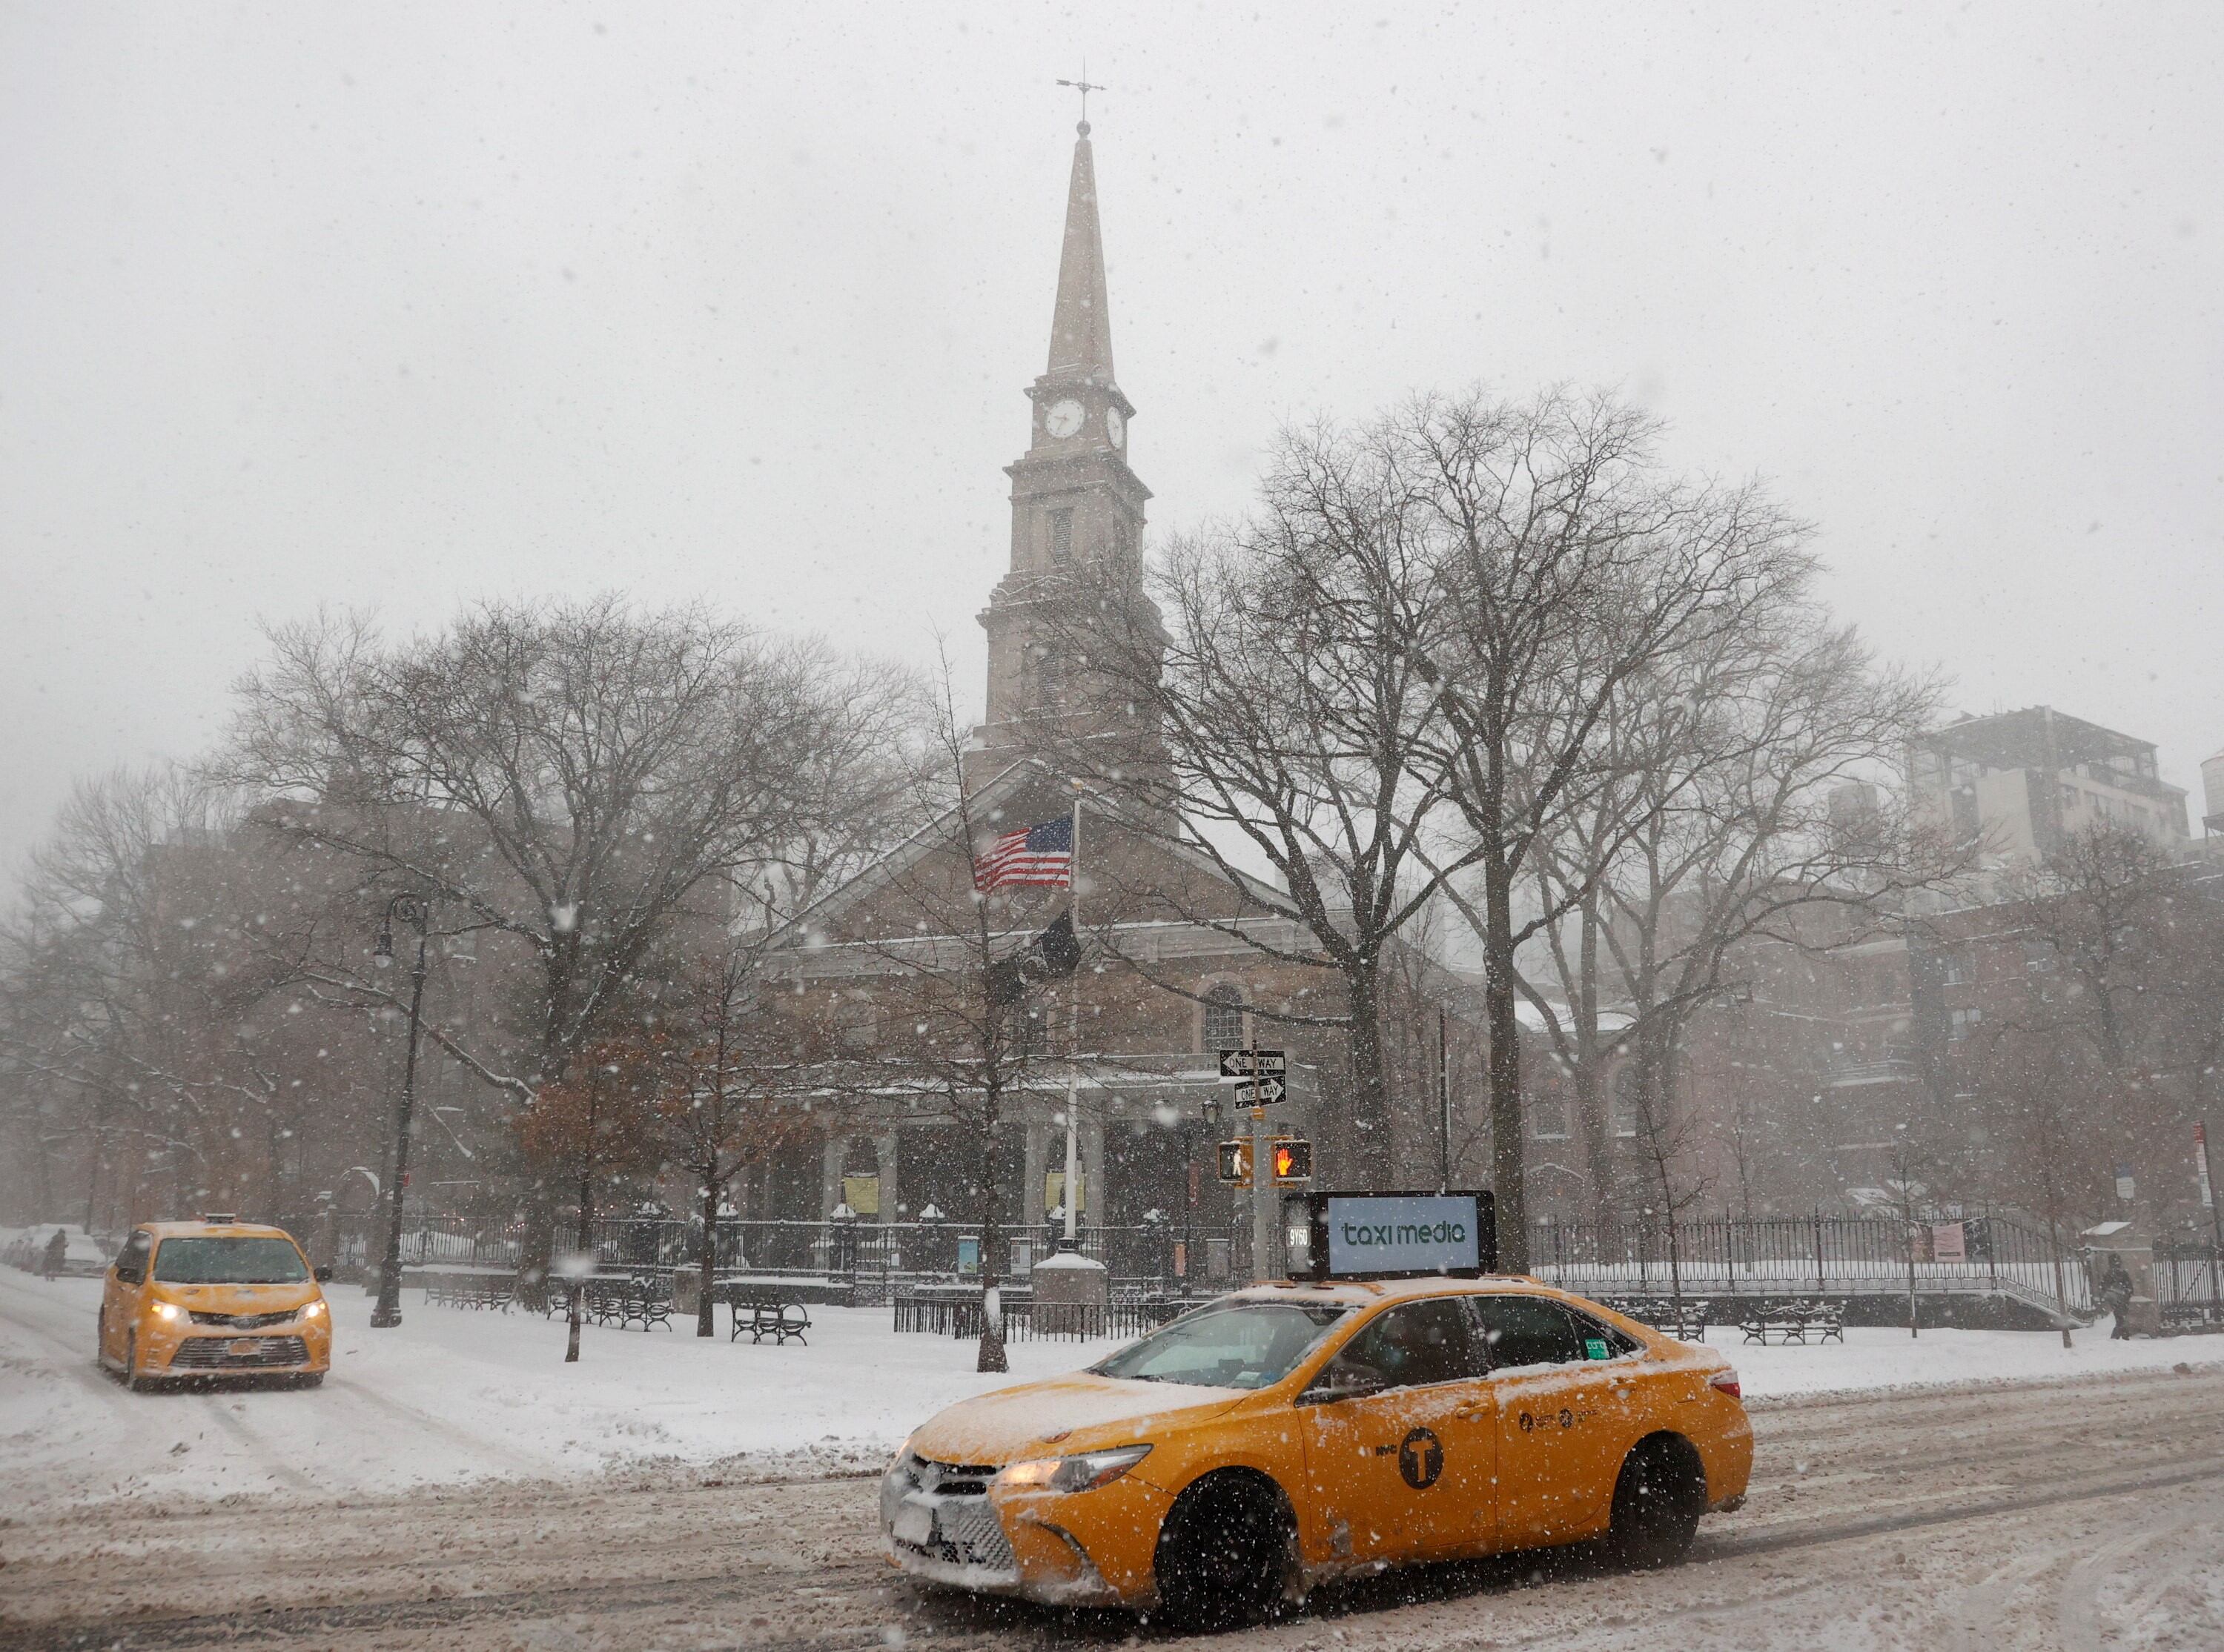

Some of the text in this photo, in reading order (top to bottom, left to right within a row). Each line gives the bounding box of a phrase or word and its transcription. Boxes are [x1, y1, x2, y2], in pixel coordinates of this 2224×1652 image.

[1229, 1058, 1277, 1069] ONE WAY
[1241, 1084, 1279, 1101] ONE WAY
[1290, 1228, 1308, 1246] 9Y60
